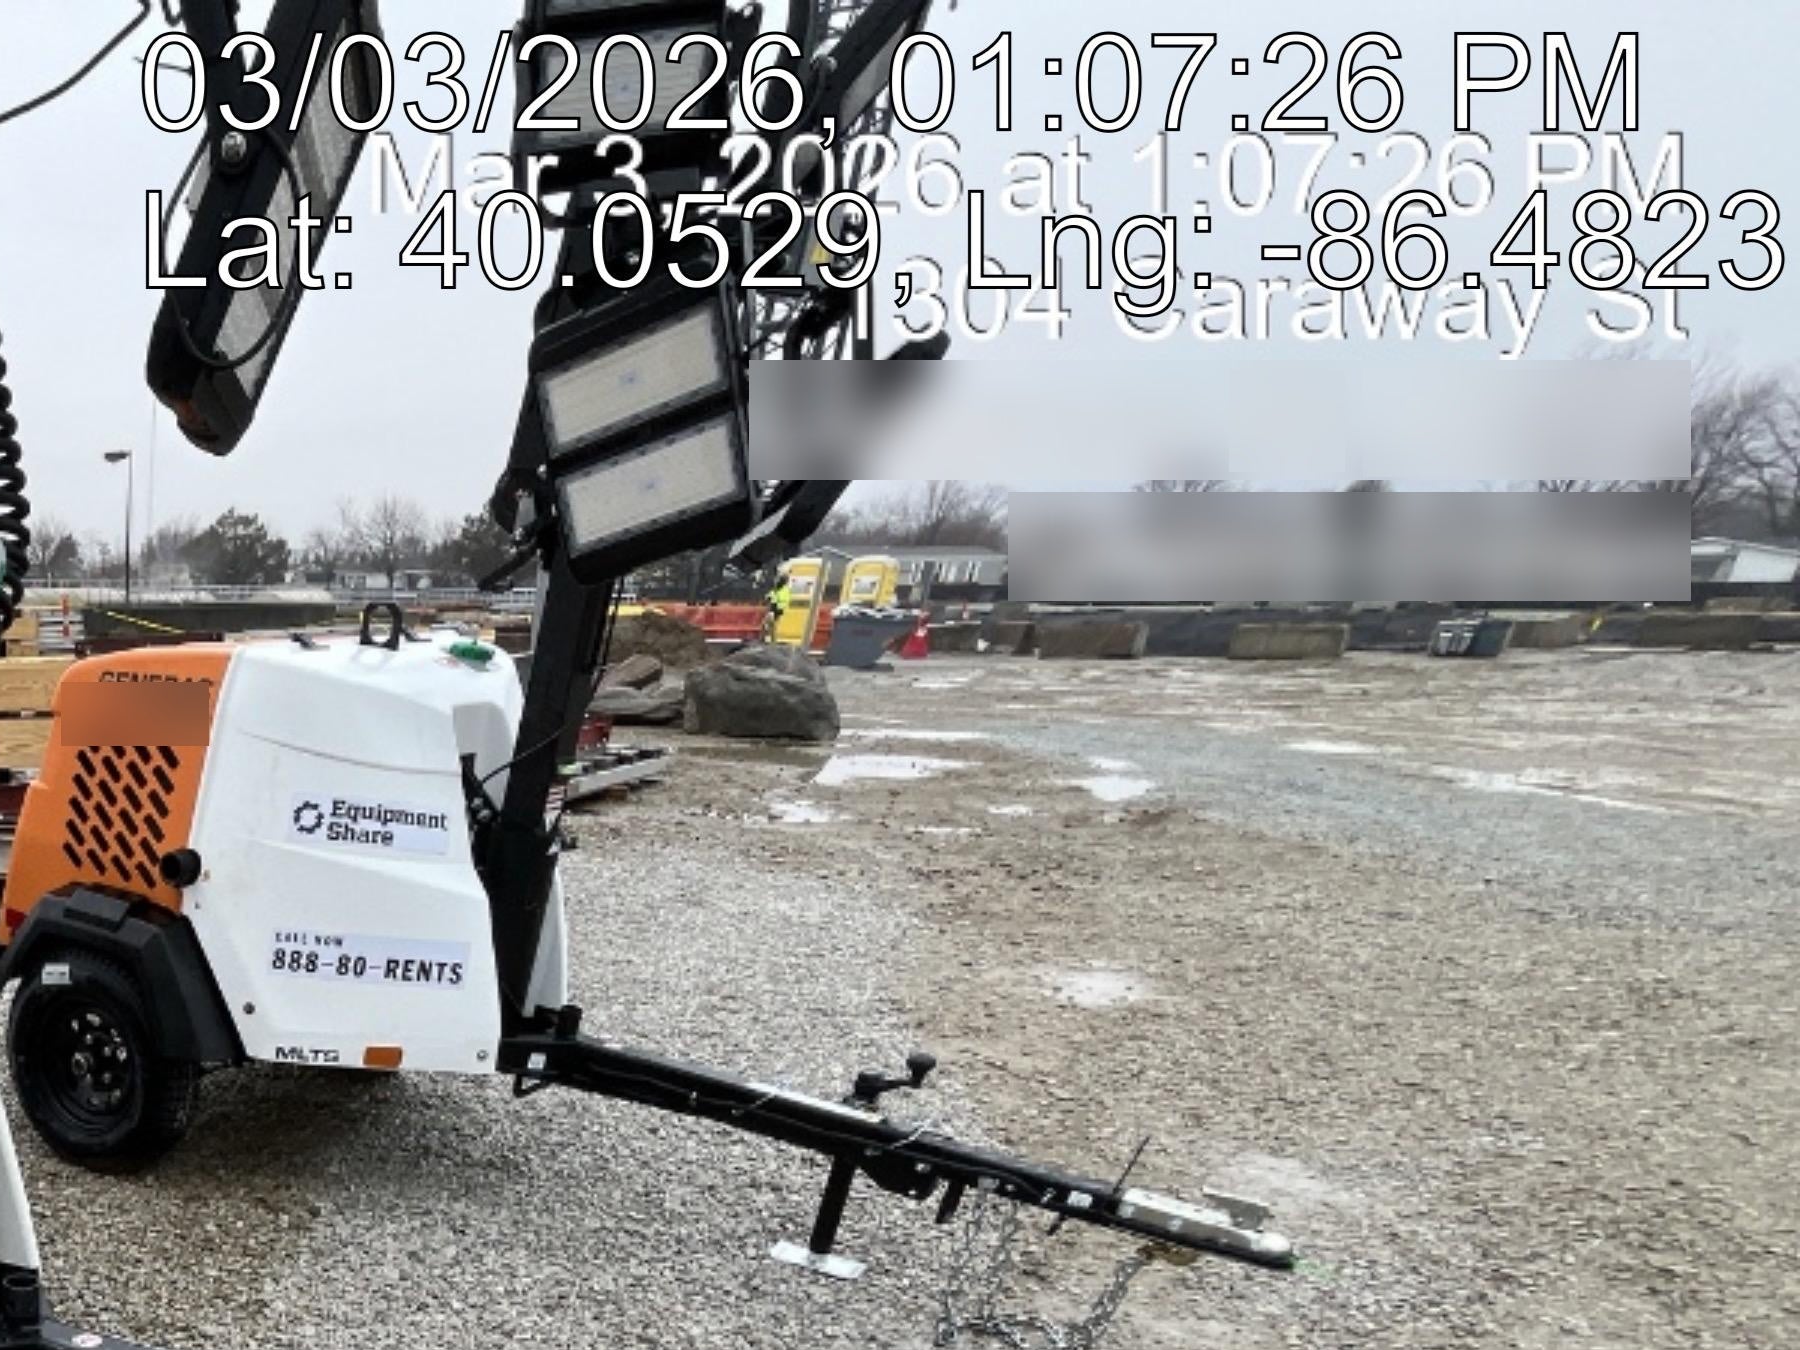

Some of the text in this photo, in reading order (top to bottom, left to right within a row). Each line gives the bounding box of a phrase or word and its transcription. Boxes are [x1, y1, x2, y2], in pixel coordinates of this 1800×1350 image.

[330, 799, 448, 832] Equipment
[327, 822, 394, 846] Share
[271, 948, 464, 985] 888-80-RENTS
[275, 1046, 340, 1064] MLTS
